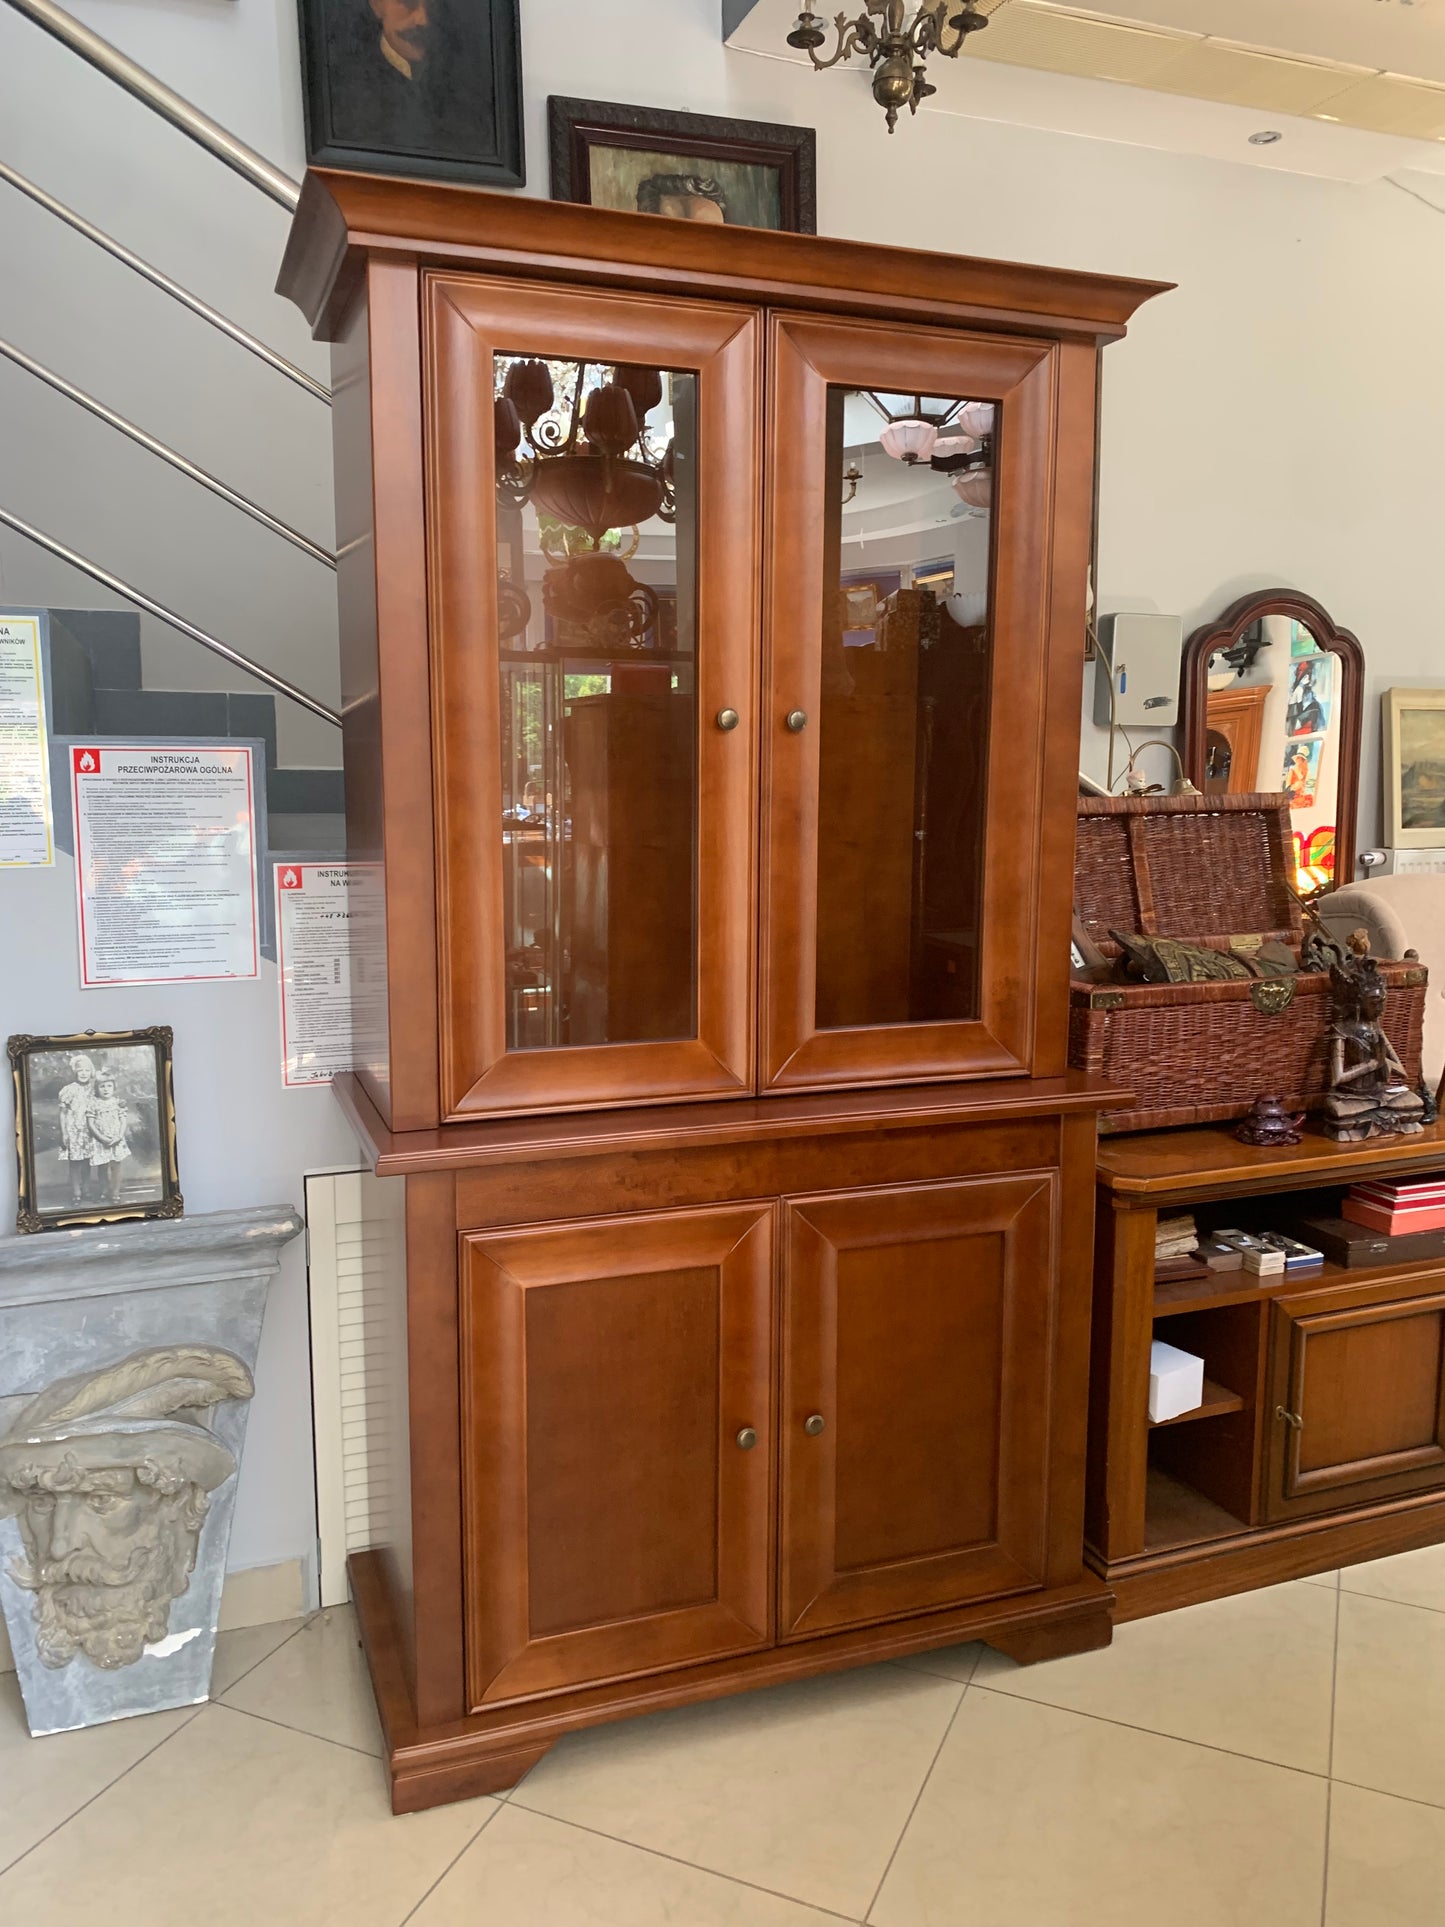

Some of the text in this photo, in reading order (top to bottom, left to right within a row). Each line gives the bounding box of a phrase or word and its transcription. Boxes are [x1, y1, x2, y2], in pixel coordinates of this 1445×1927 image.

[151, 756, 200, 764] INSTRUKCJA
[118, 765, 232, 774] PRZECIWPOŻAROWA OGÓLNA
